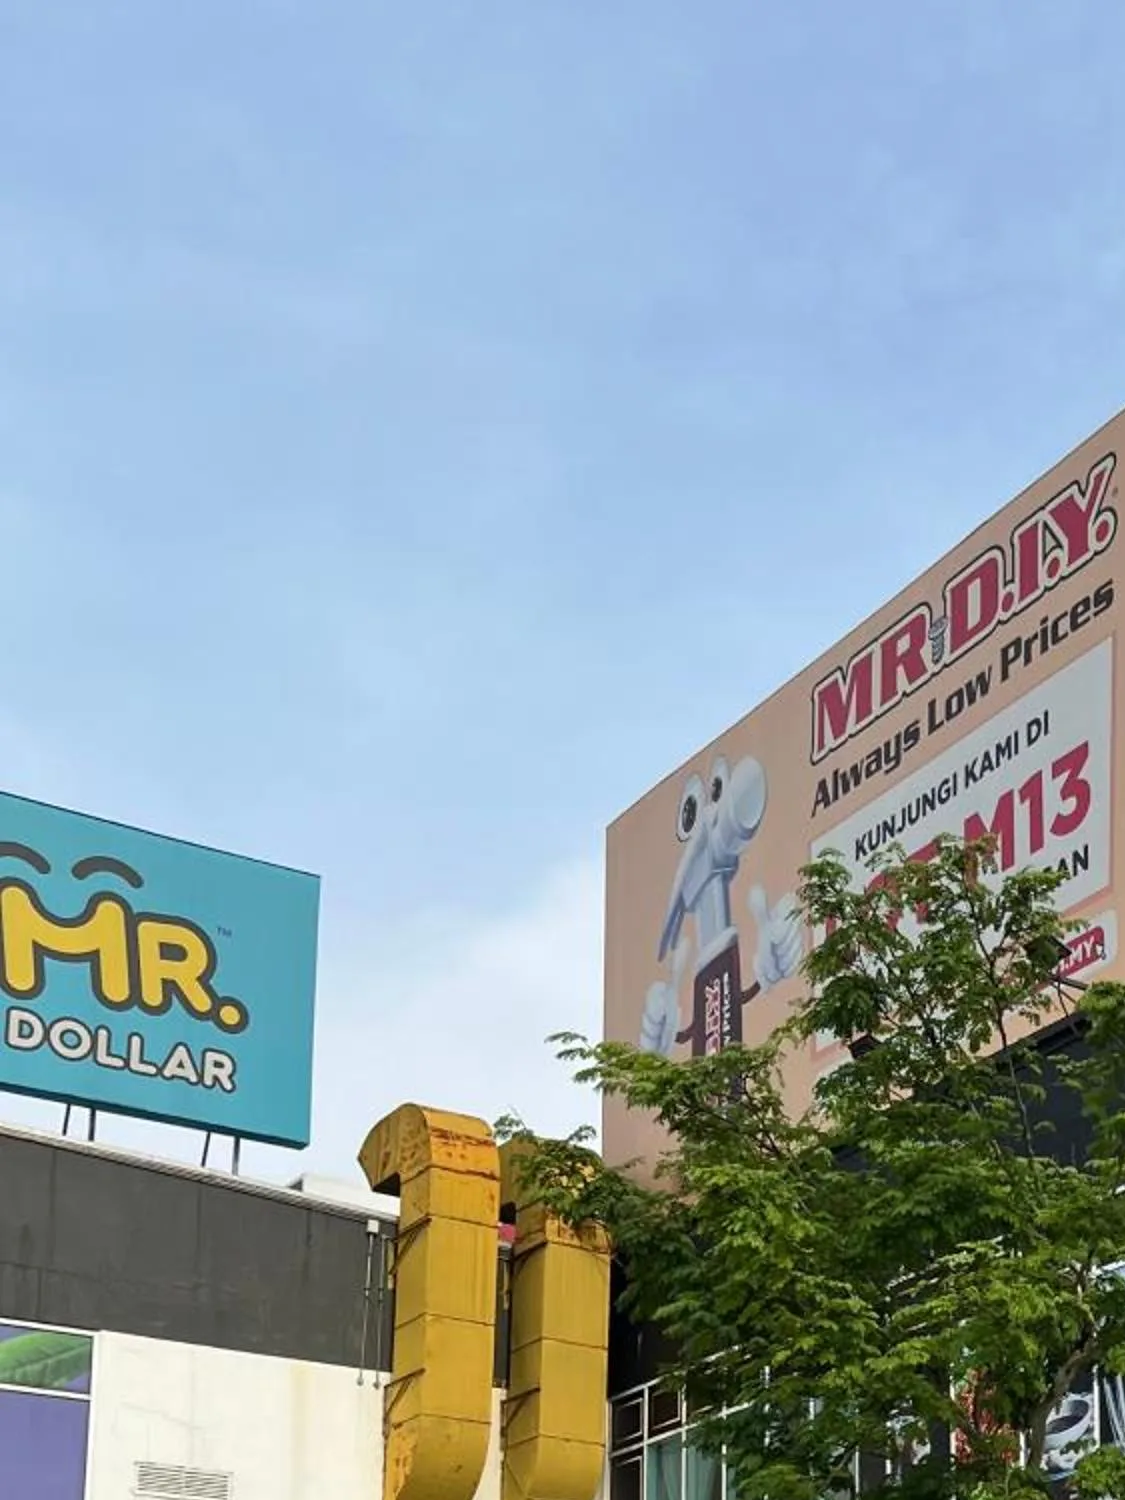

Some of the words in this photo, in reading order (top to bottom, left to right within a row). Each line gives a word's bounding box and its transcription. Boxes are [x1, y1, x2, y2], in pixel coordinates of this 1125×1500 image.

[812, 720, 920, 818] Always
[928, 667, 993, 736] Low
[1001, 578, 1114, 683] Prices
[855, 773, 957, 861] KUNJUNGI
[964, 732, 1019, 789] KAMI
[1027, 710, 1050, 747] DI
[0, 877, 249, 1034] MR.
[6, 1006, 237, 1093] DOLLAR
